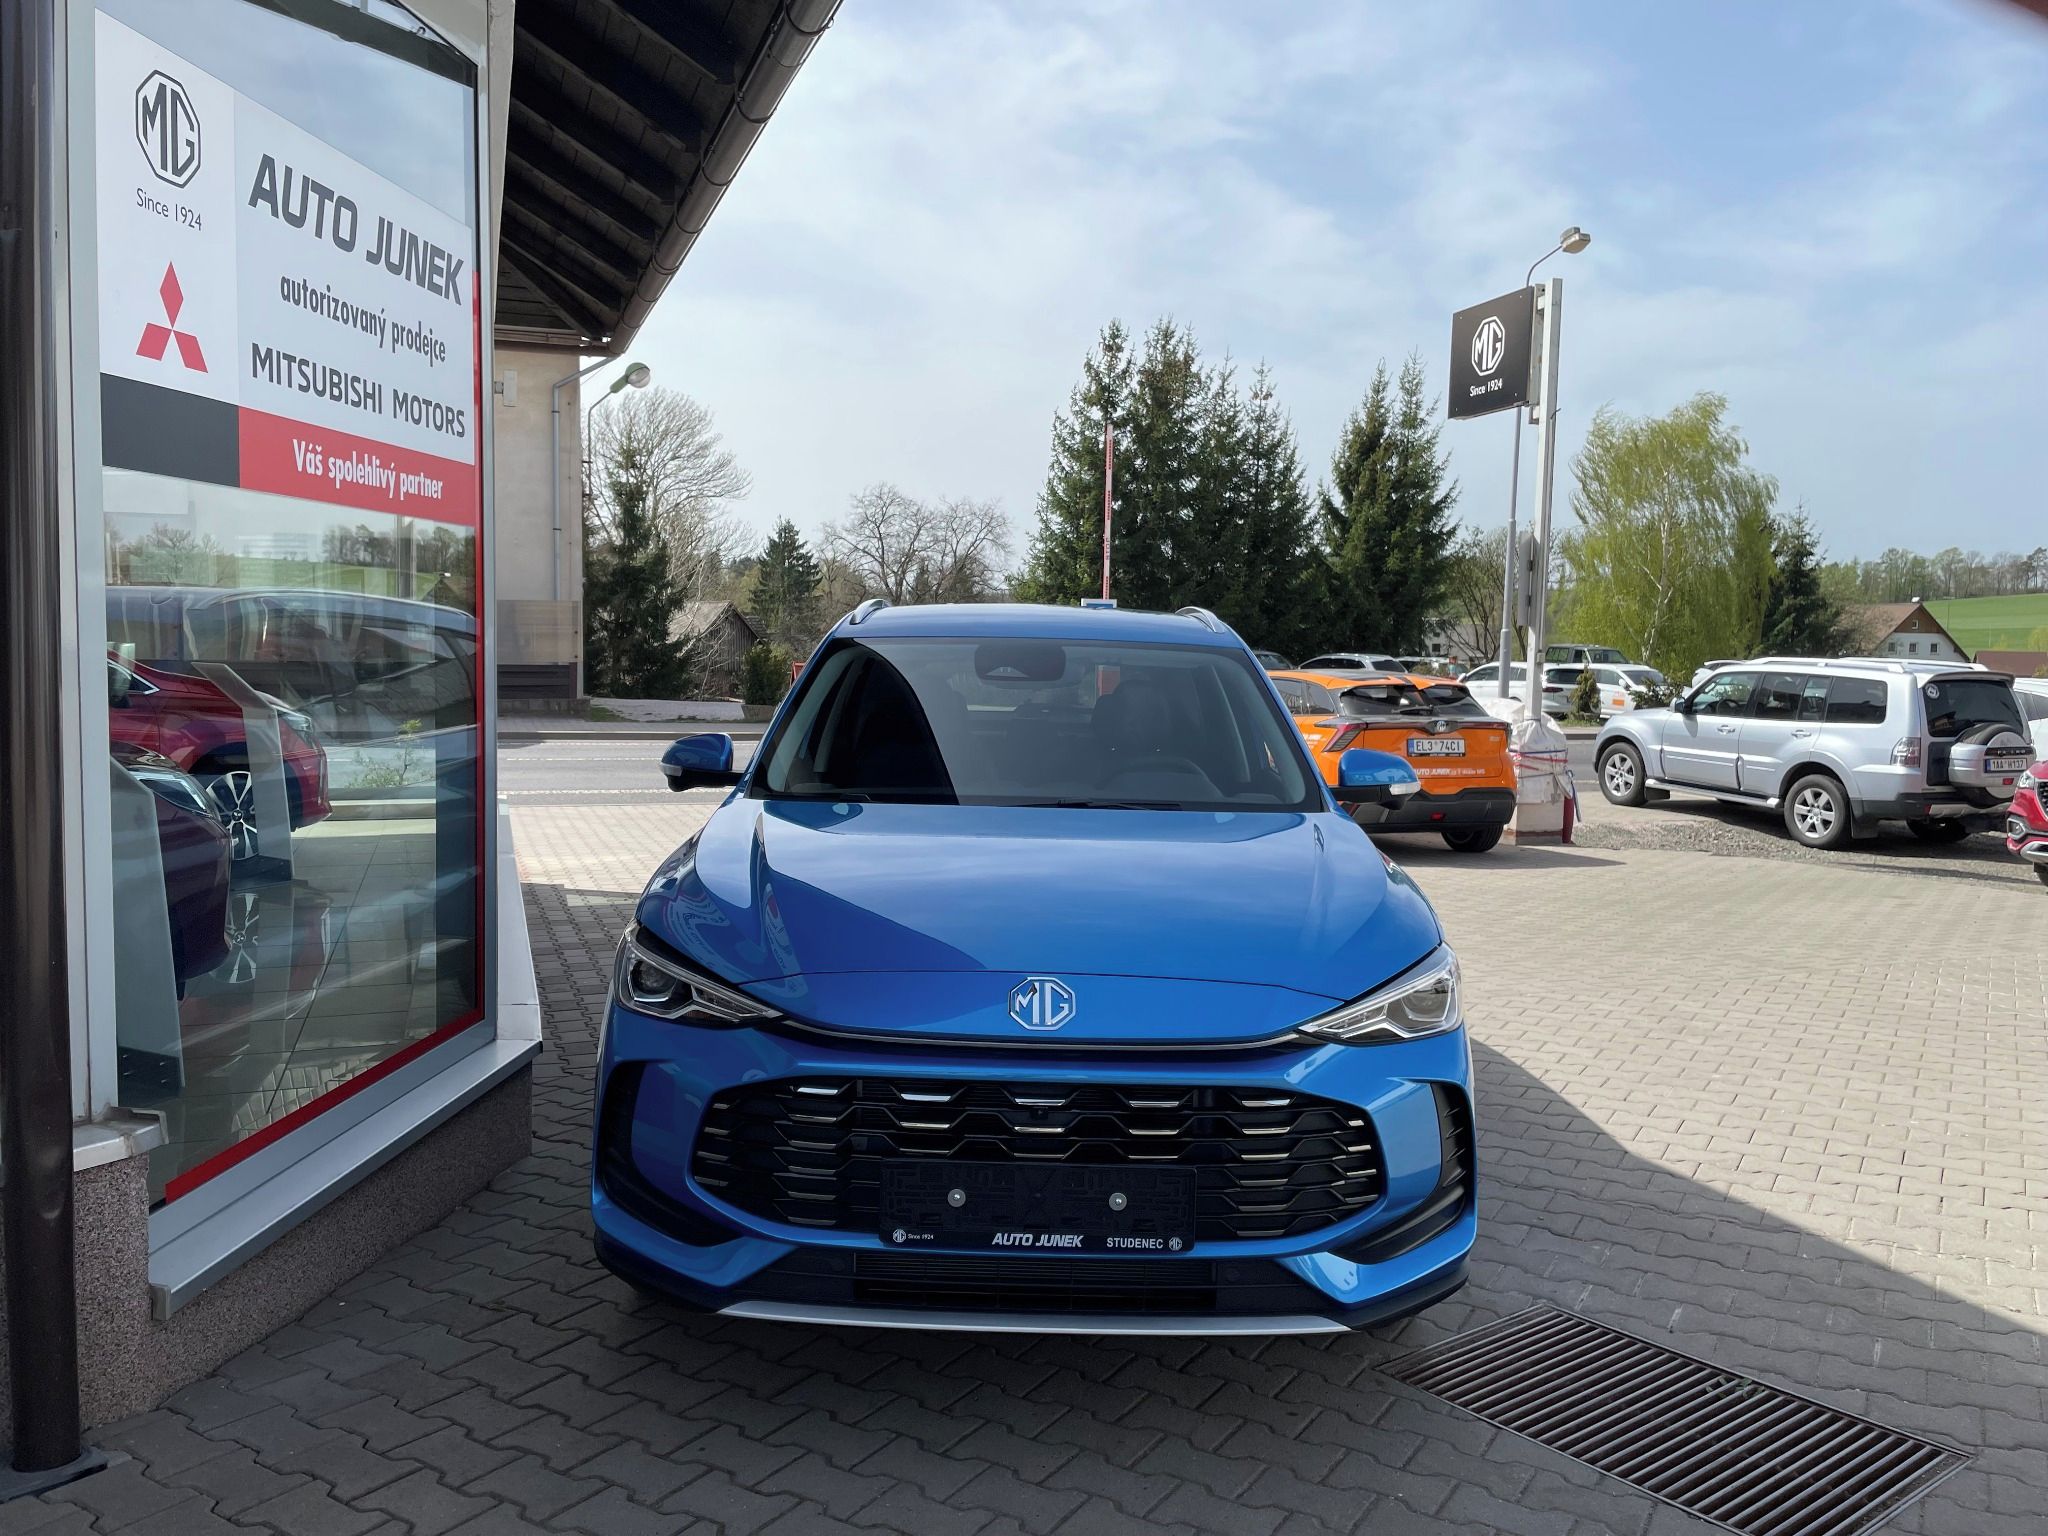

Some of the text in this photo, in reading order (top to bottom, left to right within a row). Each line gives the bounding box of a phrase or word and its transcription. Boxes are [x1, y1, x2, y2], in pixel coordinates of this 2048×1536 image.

[140, 80, 196, 179] MG
[136, 187, 202, 231] Since 1924
[247, 153, 465, 306] AUTO JUNEK
[280, 275, 446, 368] autorizovaný prodejce
[1473, 320, 1503, 372] MG
[251, 342, 466, 438] MITSUBISHI MOTORS
[1469, 377, 1503, 397] Since 1924
[292, 438, 444, 501] Váš spolehlivý partner
[1415, 741, 1433, 752] EL3
[1013, 982, 1069, 1025] MG
[893, 1229, 907, 1243] MG
[921, 1232, 934, 1240] 1924
[991, 1232, 1084, 1248] AUTO JUNEK
[1106, 1237, 1164, 1249] STUDENEC
